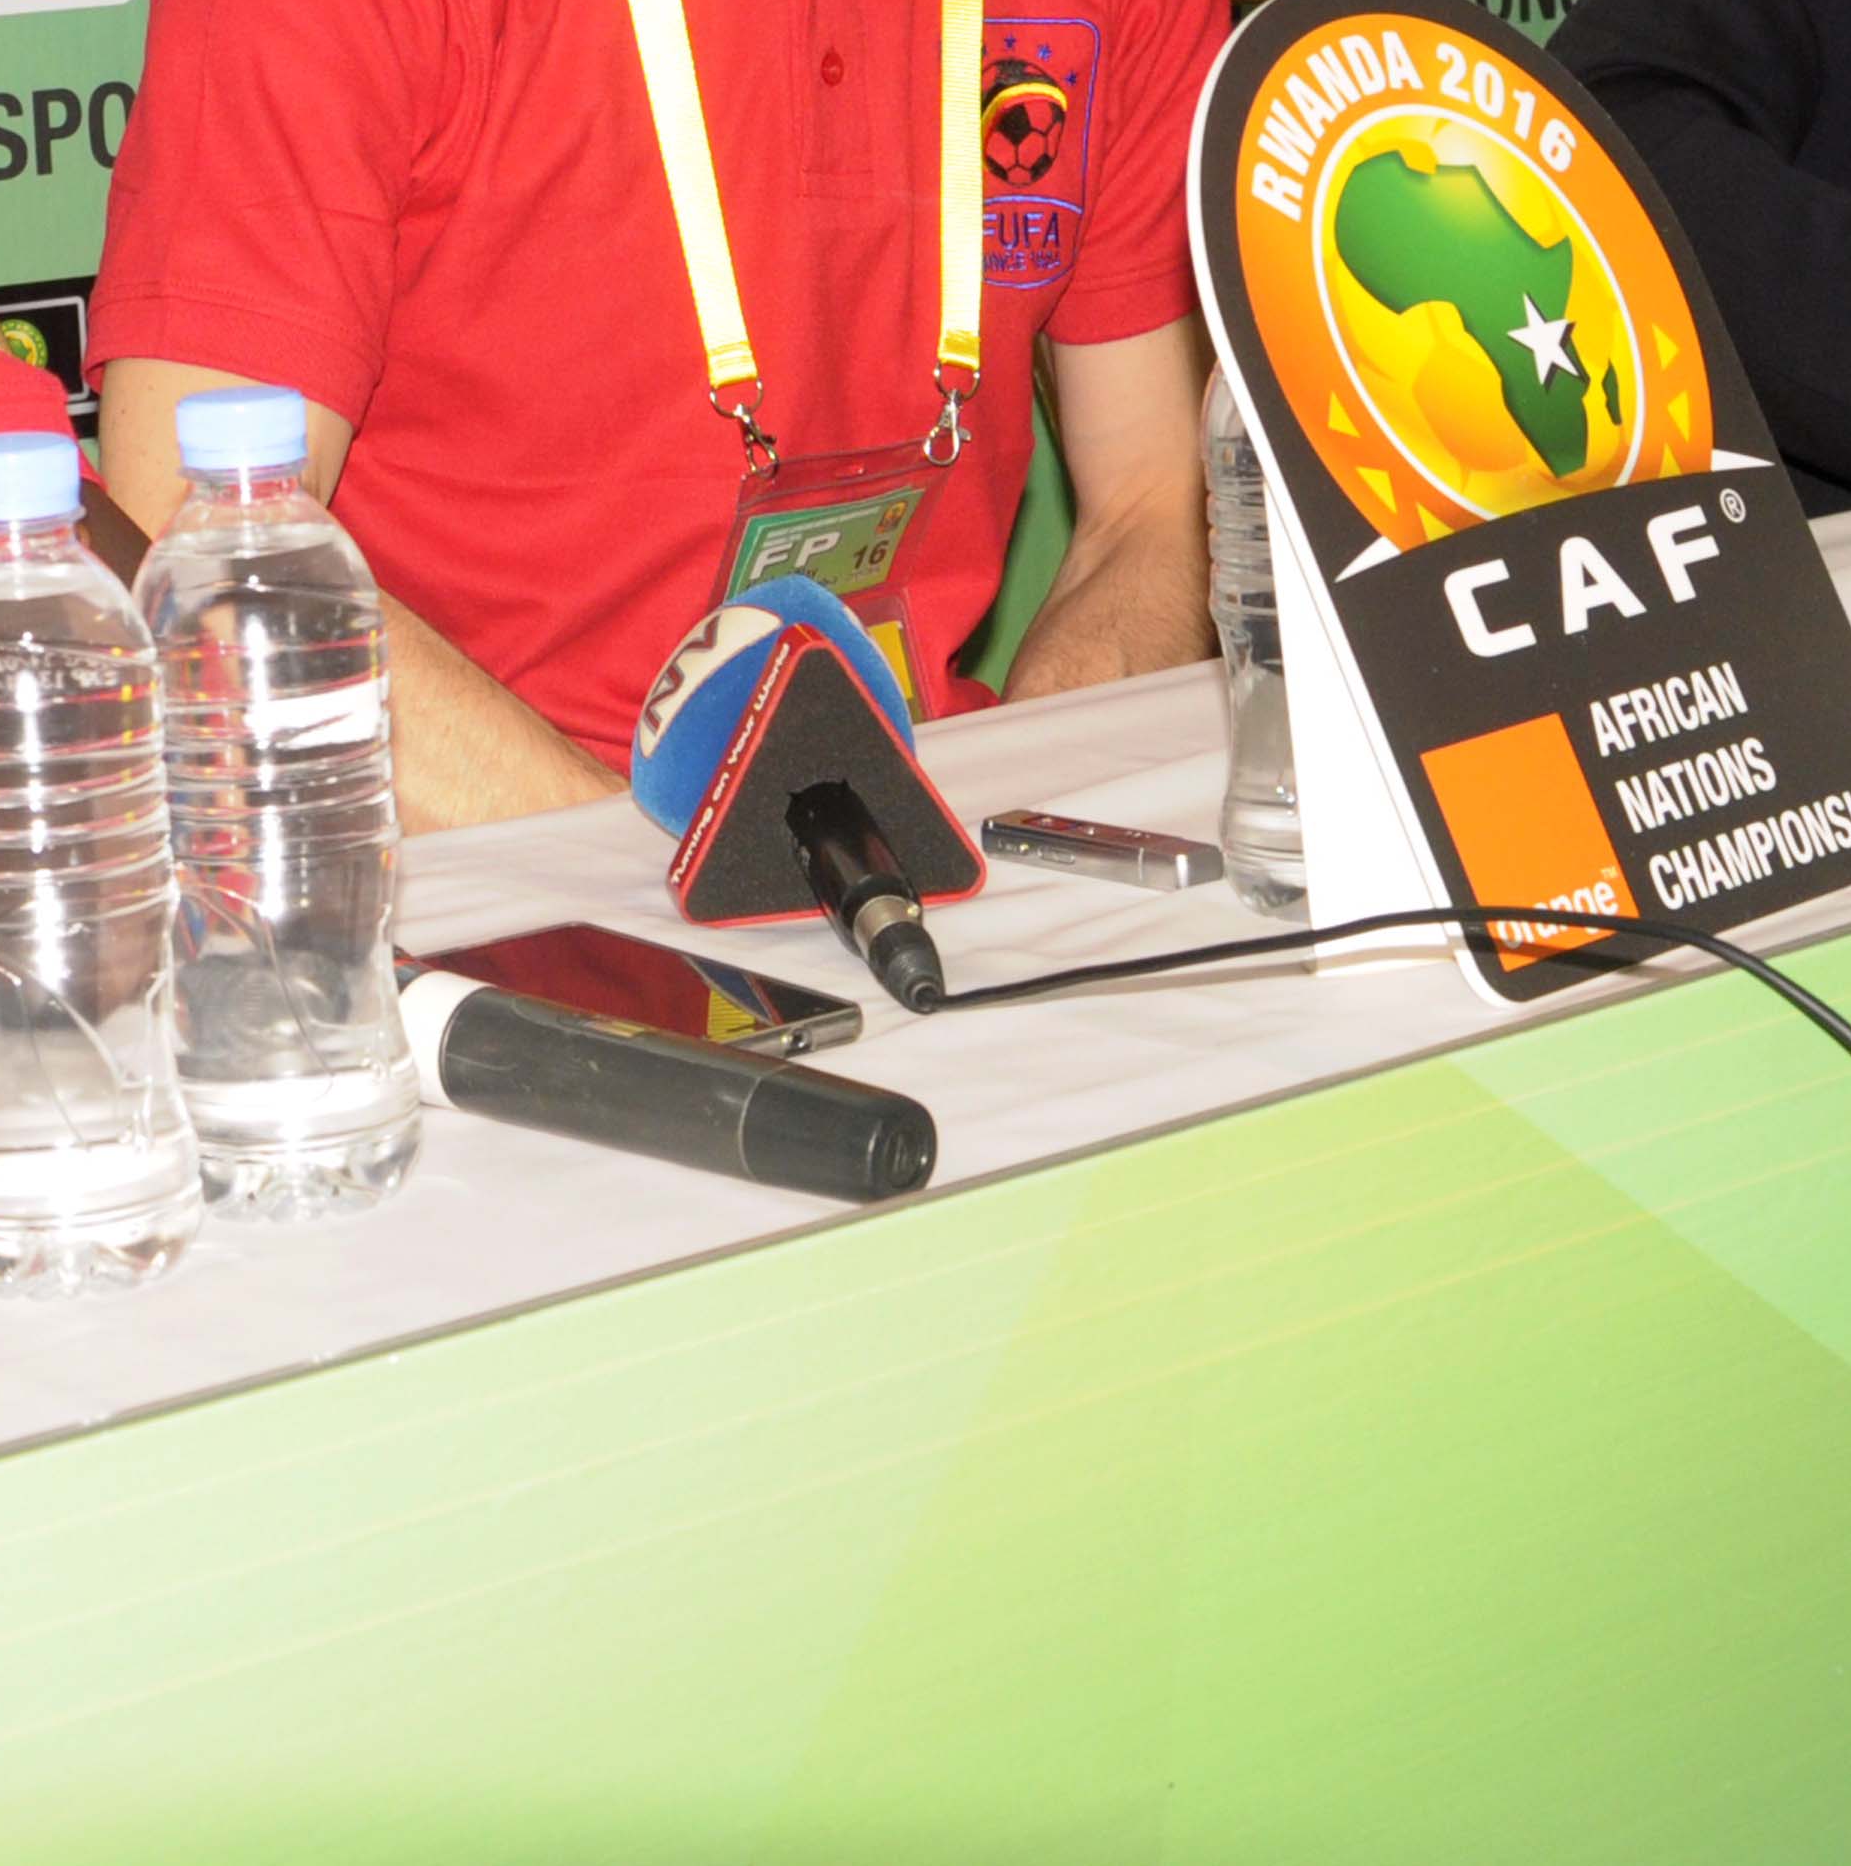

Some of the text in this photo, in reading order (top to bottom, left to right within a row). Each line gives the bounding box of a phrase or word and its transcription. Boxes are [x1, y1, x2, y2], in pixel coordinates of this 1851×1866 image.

[1251, 30, 1577, 222] RWANDA 2016
[749, 531, 841, 580] FP
[853, 540, 890, 570] 16
[1443, 504, 1721, 659] CAF
[1588, 661, 1748, 758] AFRICAN
[1614, 736, 1777, 834] NATIONS
